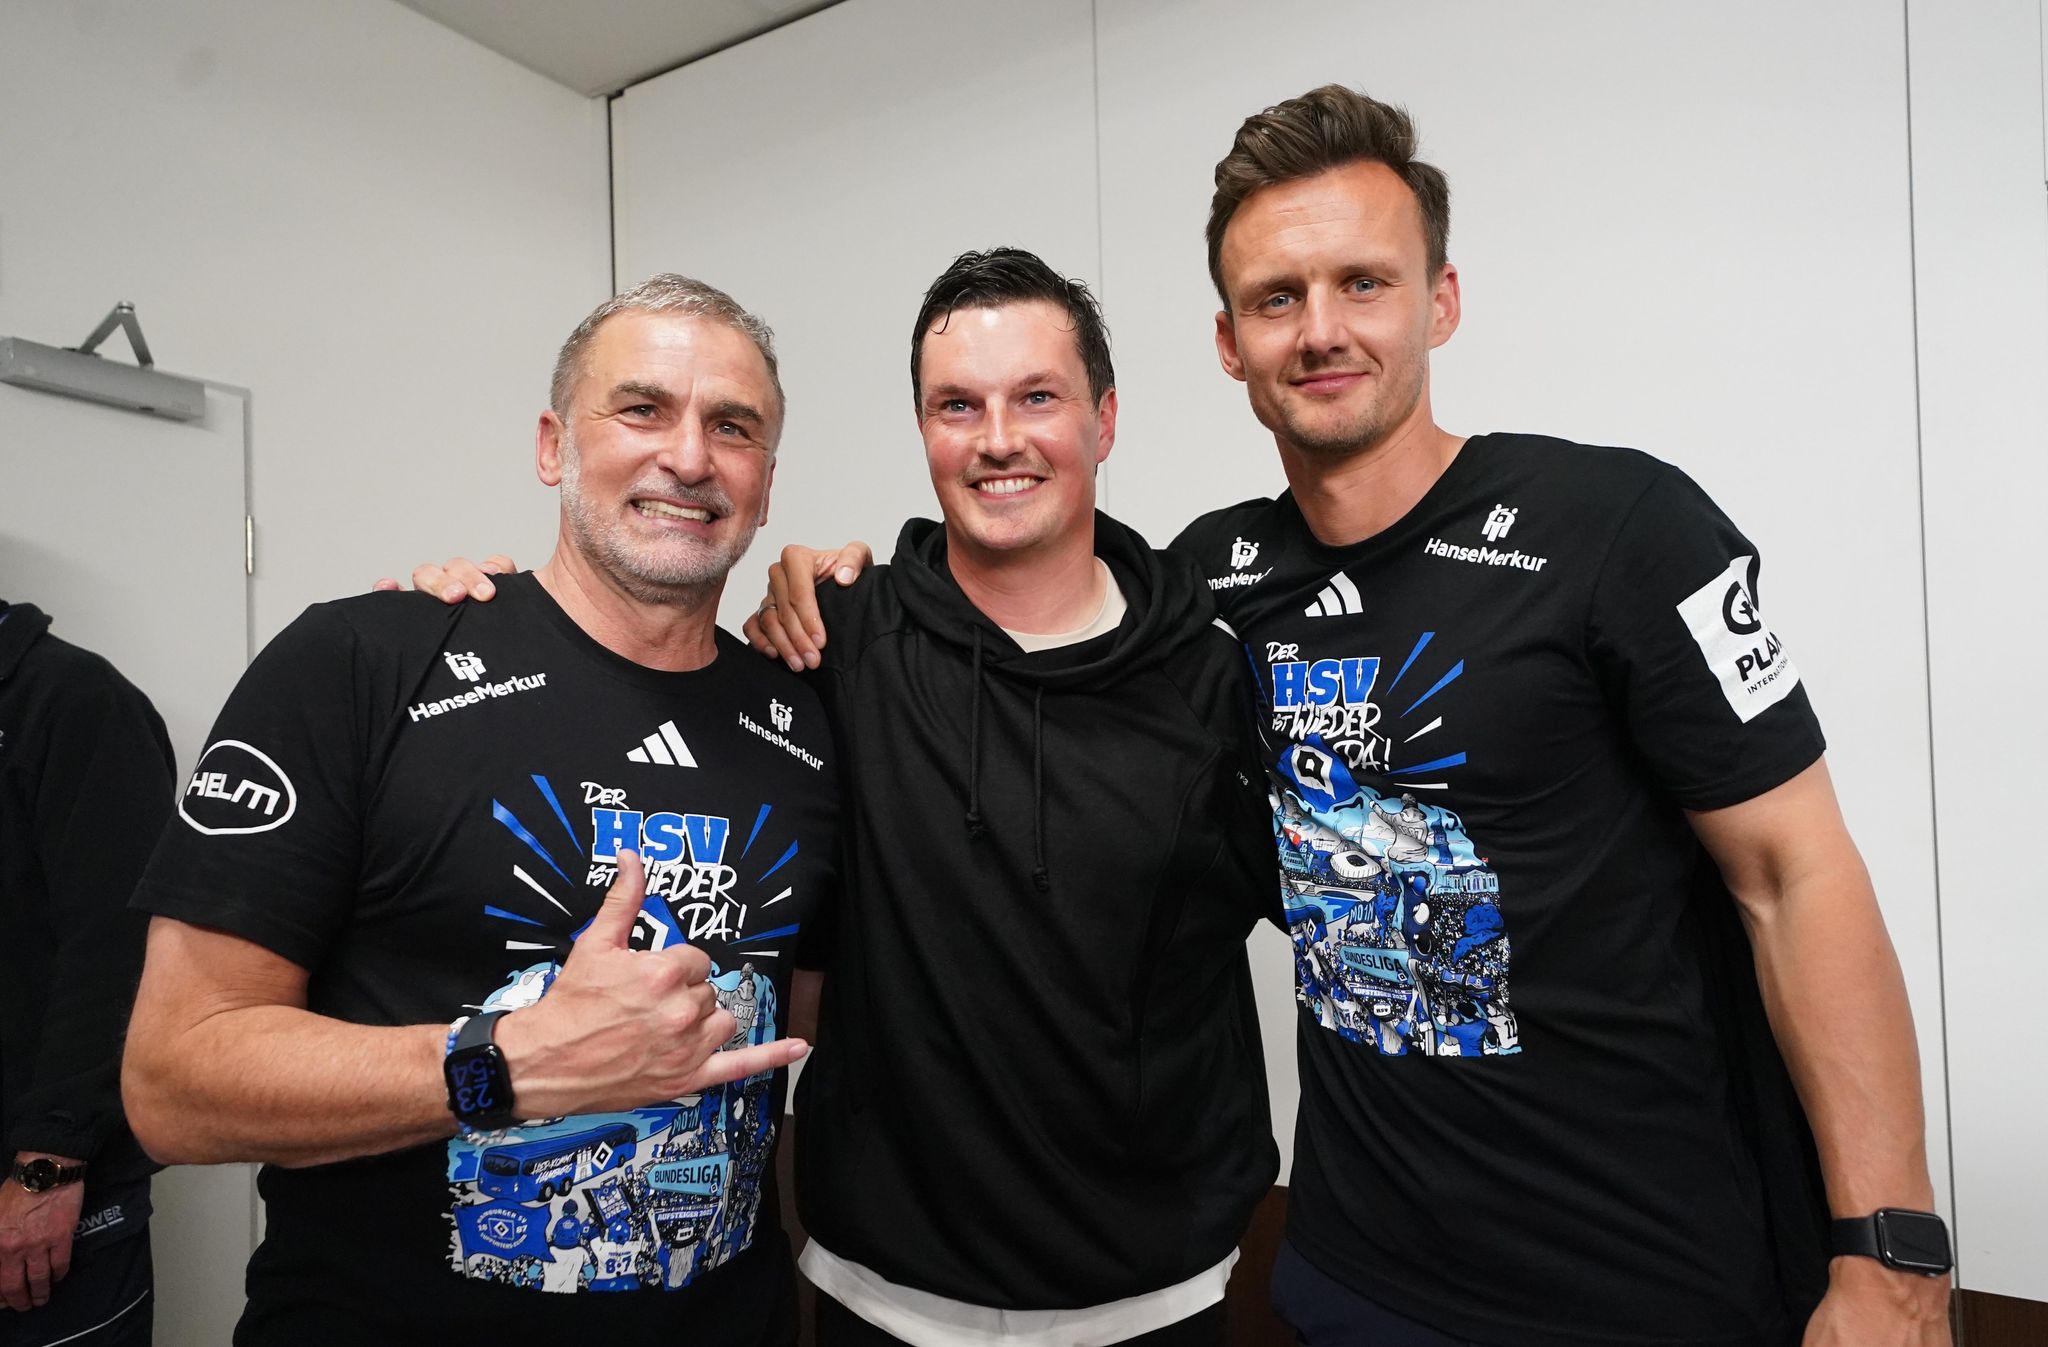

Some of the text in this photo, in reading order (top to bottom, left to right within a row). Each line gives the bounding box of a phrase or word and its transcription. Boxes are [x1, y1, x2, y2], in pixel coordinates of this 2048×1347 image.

[1423, 537, 1547, 572] HanseMerkur
[1266, 641, 1299, 662] DER
[407, 672, 547, 722] HanseMerkur
[1272, 656, 1381, 712] HSV
[739, 711, 824, 771] HanseMerkur
[1332, 737, 1391, 771] DA!
[580, 781, 630, 810] DER
[592, 806, 730, 868] HSV
[677, 902, 748, 942] DA!
[1343, 950, 1406, 976] BUNDESLIGA
[733, 1003, 754, 1019] 1887
[1504, 1020, 1517, 1039] 11
[455, 1083, 493, 1114] 23
[655, 1163, 722, 1185] BUNDESLIGA
[657, 1210, 699, 1221] AUFSTEIGER
